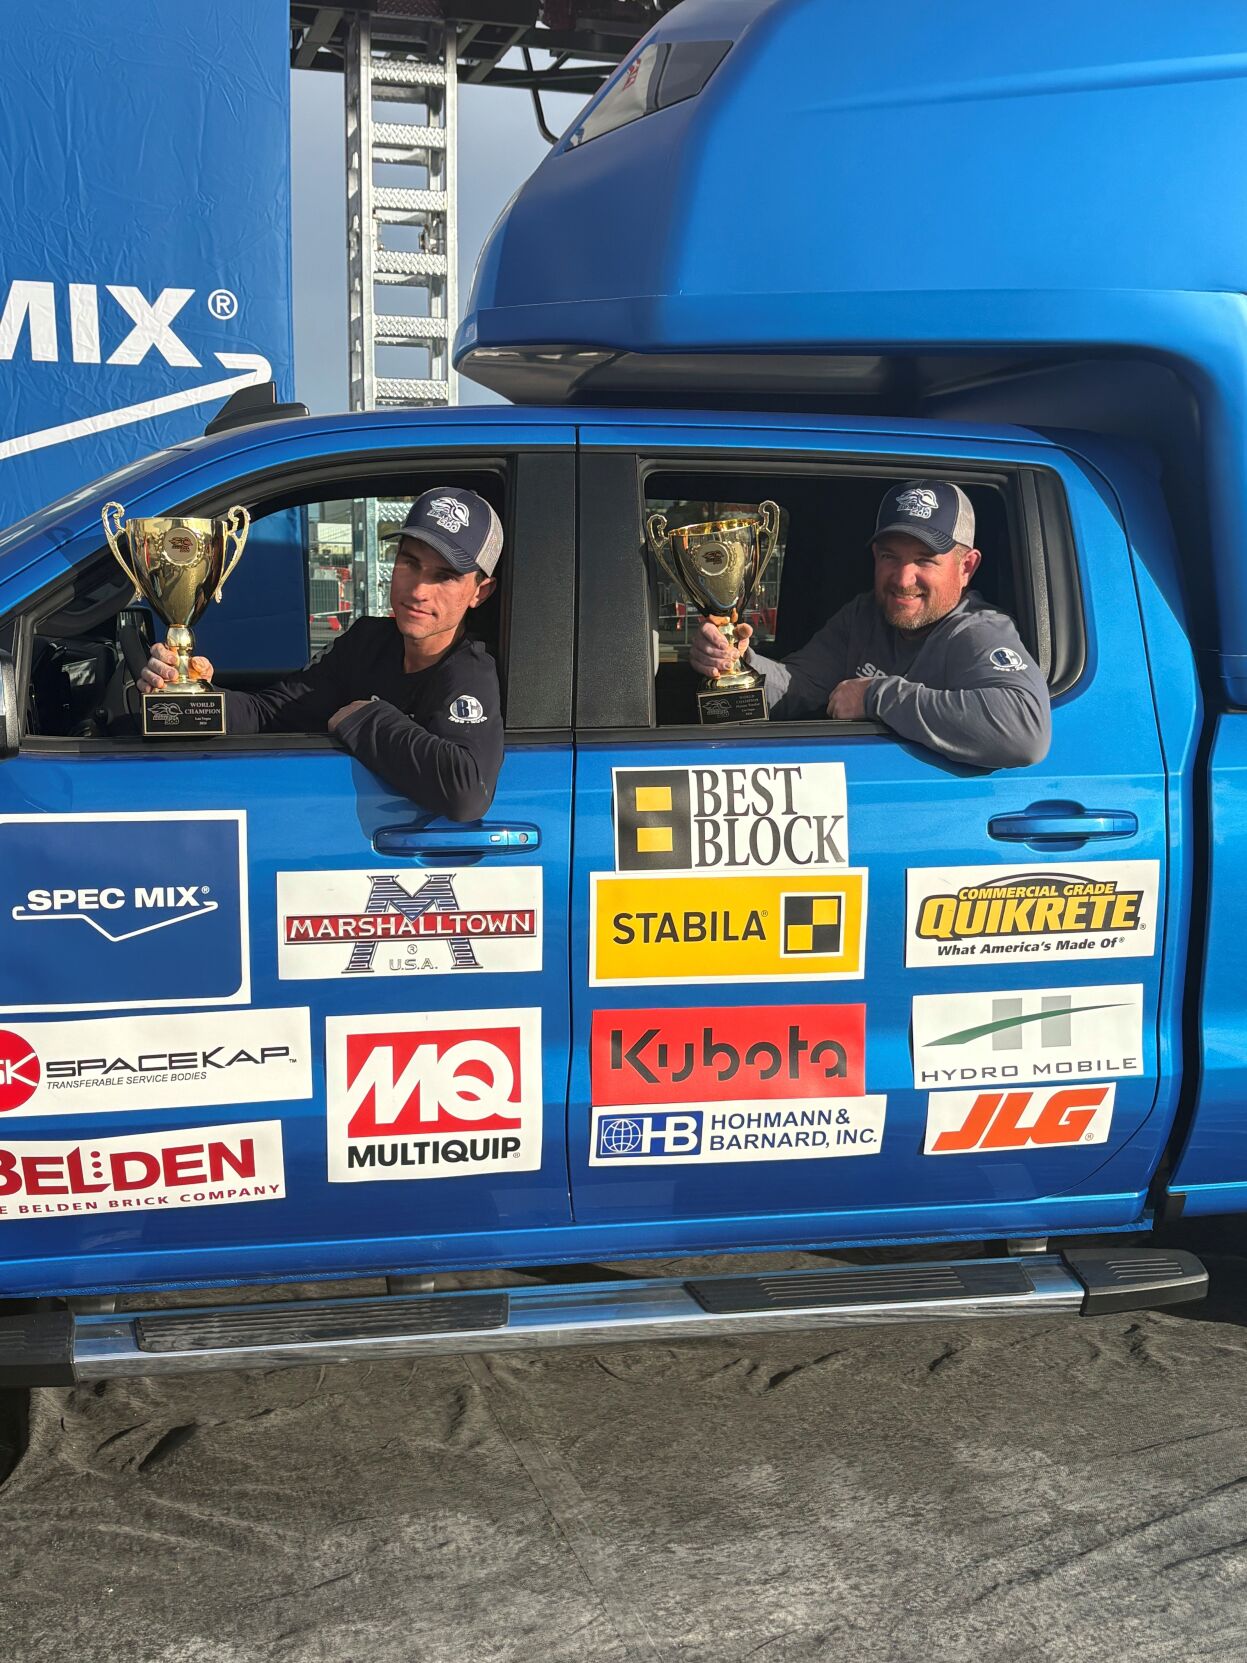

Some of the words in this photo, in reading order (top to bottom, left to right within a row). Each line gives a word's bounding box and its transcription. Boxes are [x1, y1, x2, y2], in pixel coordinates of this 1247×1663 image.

[692, 766, 802, 818] BEST
[693, 815, 846, 867] BLOCK
[27, 887, 126, 911] SPEC
[958, 885, 1059, 901] COMMERCIAL
[1063, 883, 1115, 897] GRADE
[290, 913, 532, 939] MARSHALLTOWN
[937, 944, 976, 956] What
[979, 941, 1052, 954] America's
[1056, 939, 1096, 950] Made
[388, 957, 439, 972] U.S.A.
[610, 1025, 848, 1084] Kubota
[0, 1052, 38, 1087] K
[46, 1075, 125, 1090] TRANSFERABLE
[126, 1073, 169, 1085] SERVICE
[170, 1071, 208, 1082] BODIES
[347, 1039, 521, 1124] MQ
[921, 1065, 1019, 1082] HYDRO
[1033, 1057, 1137, 1075] MOBILE
[711, 1109, 832, 1130] HOHMANN
[835, 1108, 851, 1125] &
[709, 1131, 830, 1151] BARNARD,
[836, 1128, 878, 1145] INC.
[18, 1200, 98, 1214] BELDEN
[109, 1195, 169, 1209] BRICK
[180, 1184, 280, 1203] COMPANY
